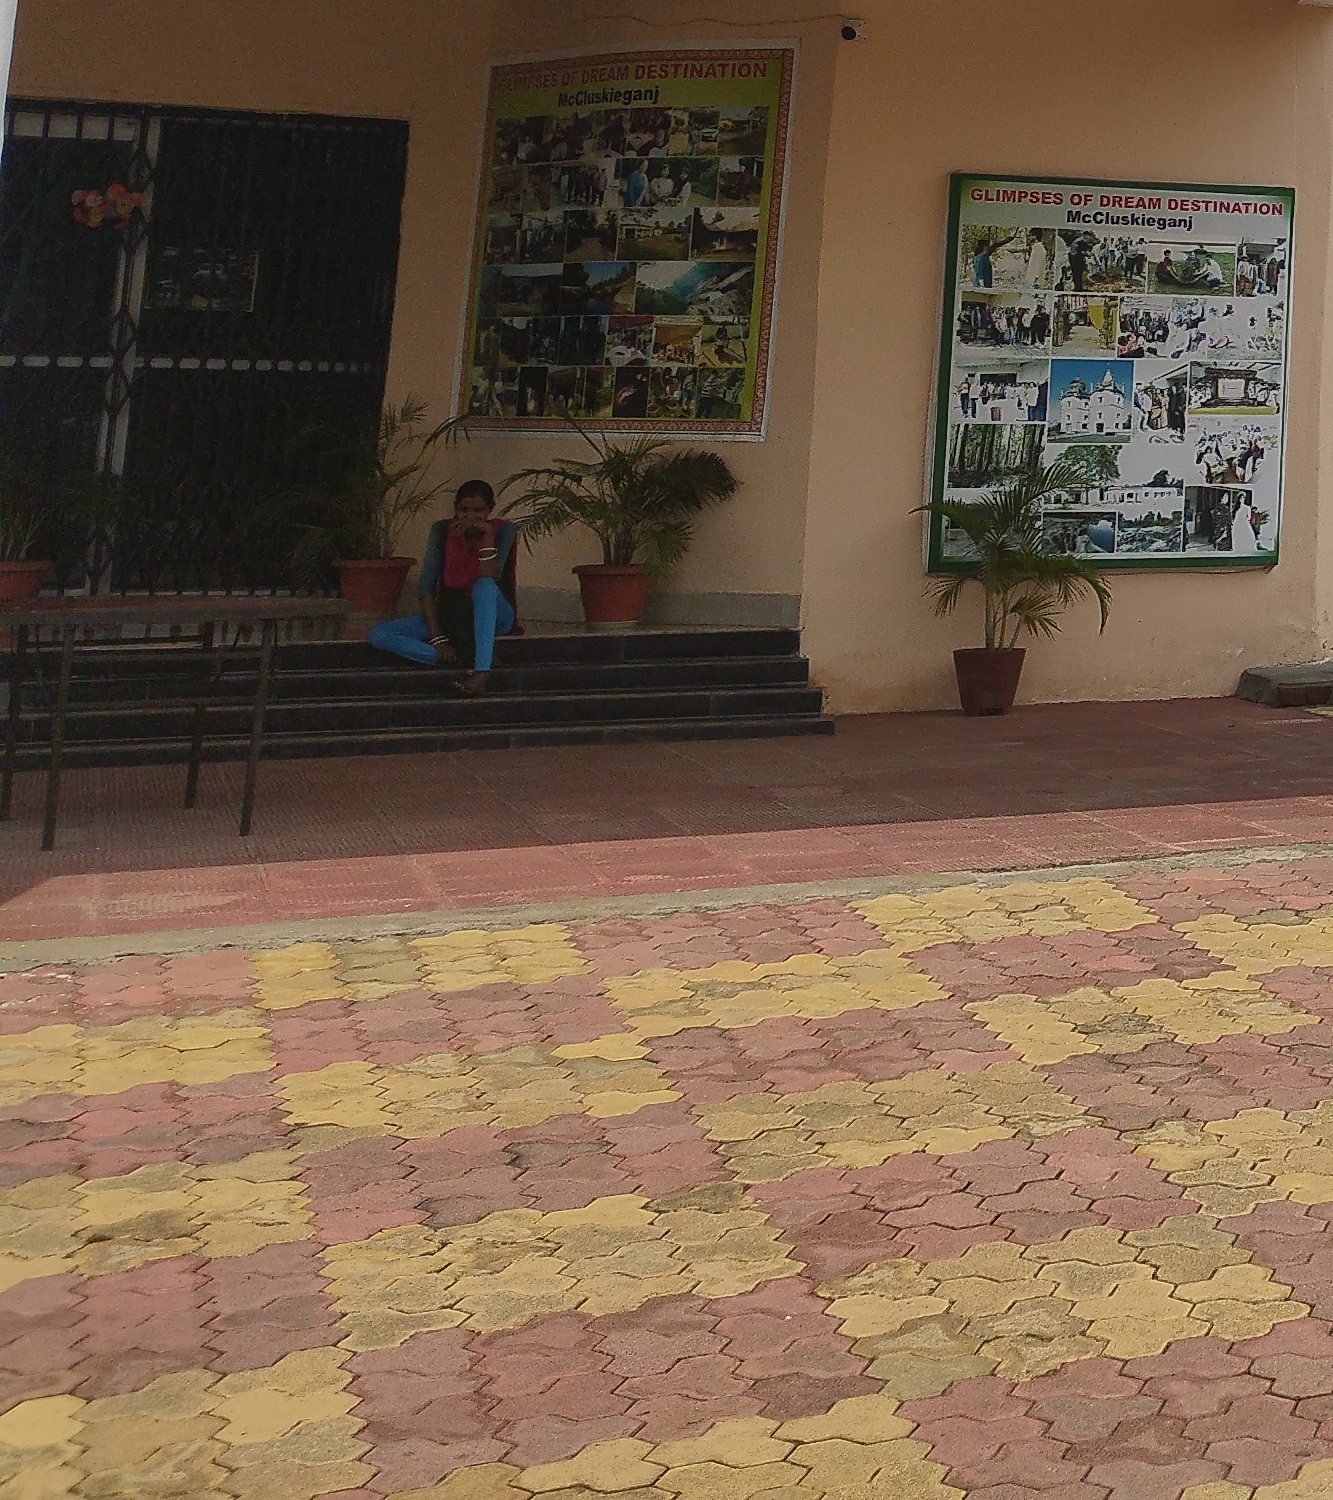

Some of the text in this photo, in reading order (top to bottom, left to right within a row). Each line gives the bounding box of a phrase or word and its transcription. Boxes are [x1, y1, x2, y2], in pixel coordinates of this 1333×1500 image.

[581, 66, 629, 84] DREAM
[634, 62, 768, 82] DESTINATION
[558, 86, 659, 107] McCluskieganj
[970, 188, 1284, 216] GLIMPSES OF DREAM DESTINATION
[1066, 209, 1194, 231] McCluskieganj
